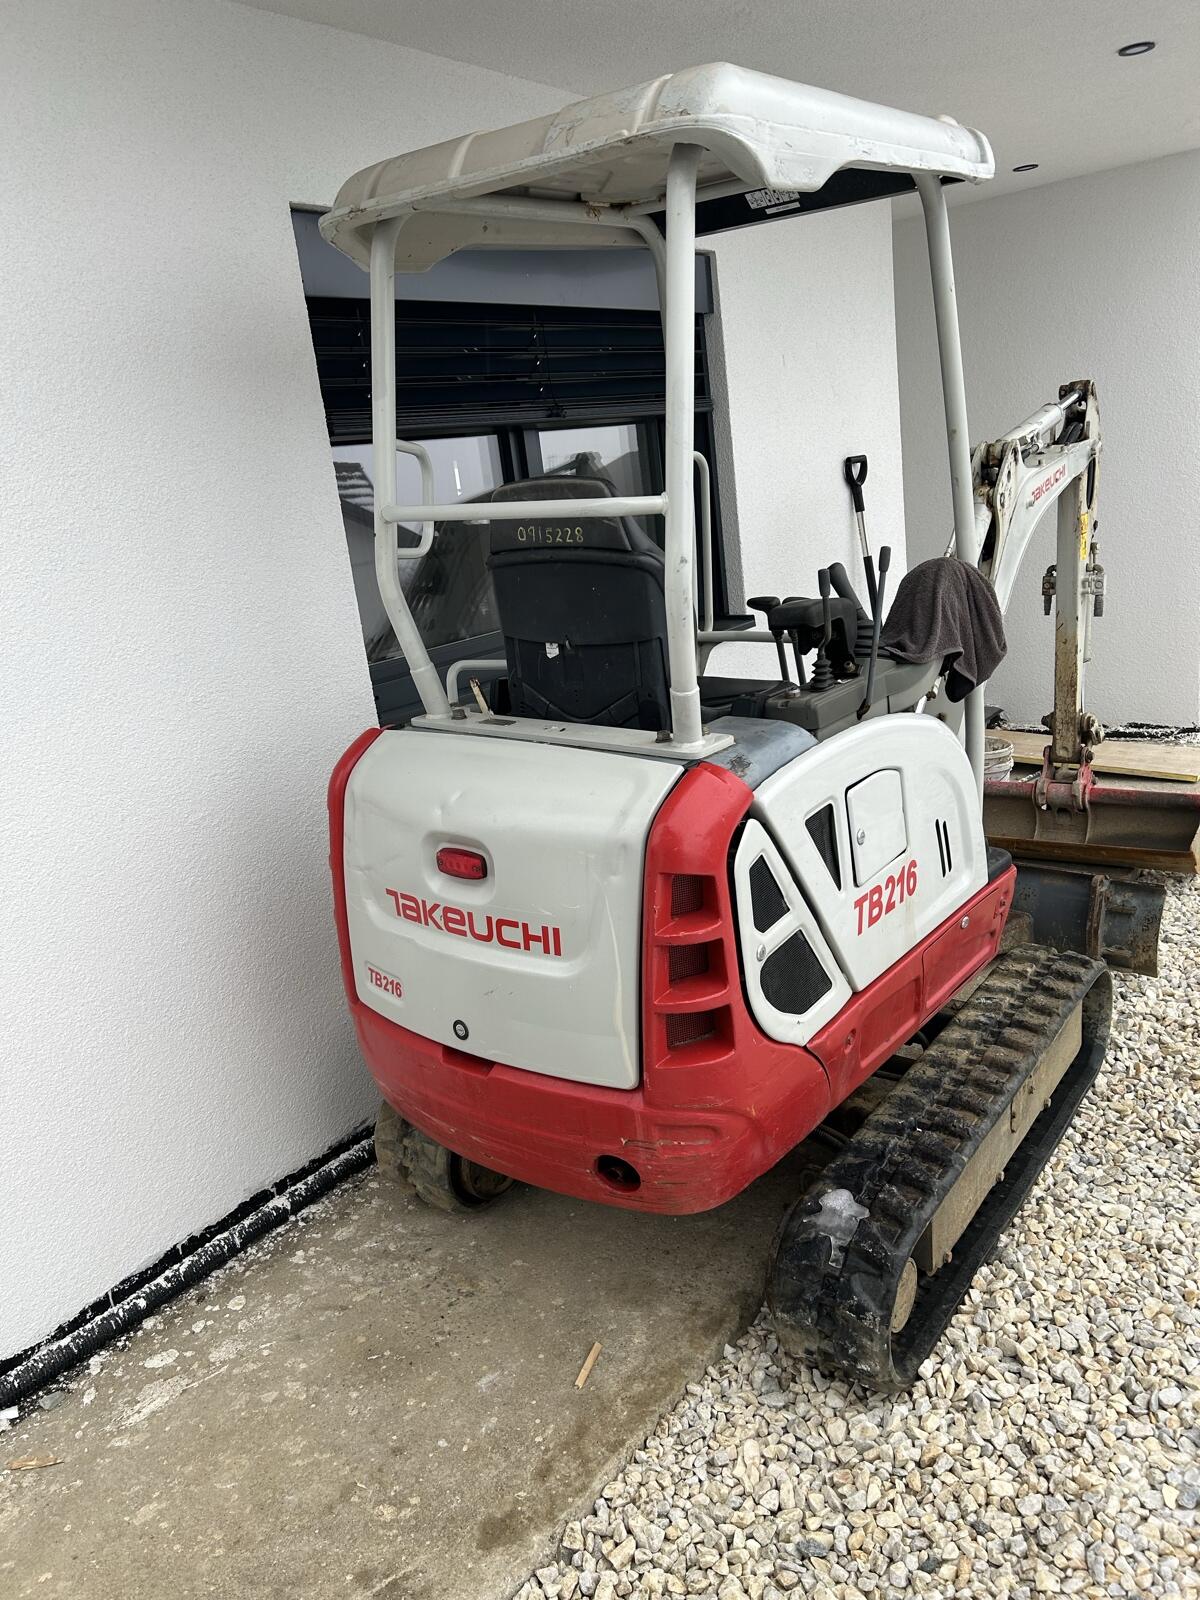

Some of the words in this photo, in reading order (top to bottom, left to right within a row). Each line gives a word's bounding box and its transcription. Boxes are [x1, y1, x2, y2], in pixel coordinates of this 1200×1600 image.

[517, 525, 584, 543] 0915228
[853, 859, 917, 937] TB216
[367, 966, 402, 998] TB216
